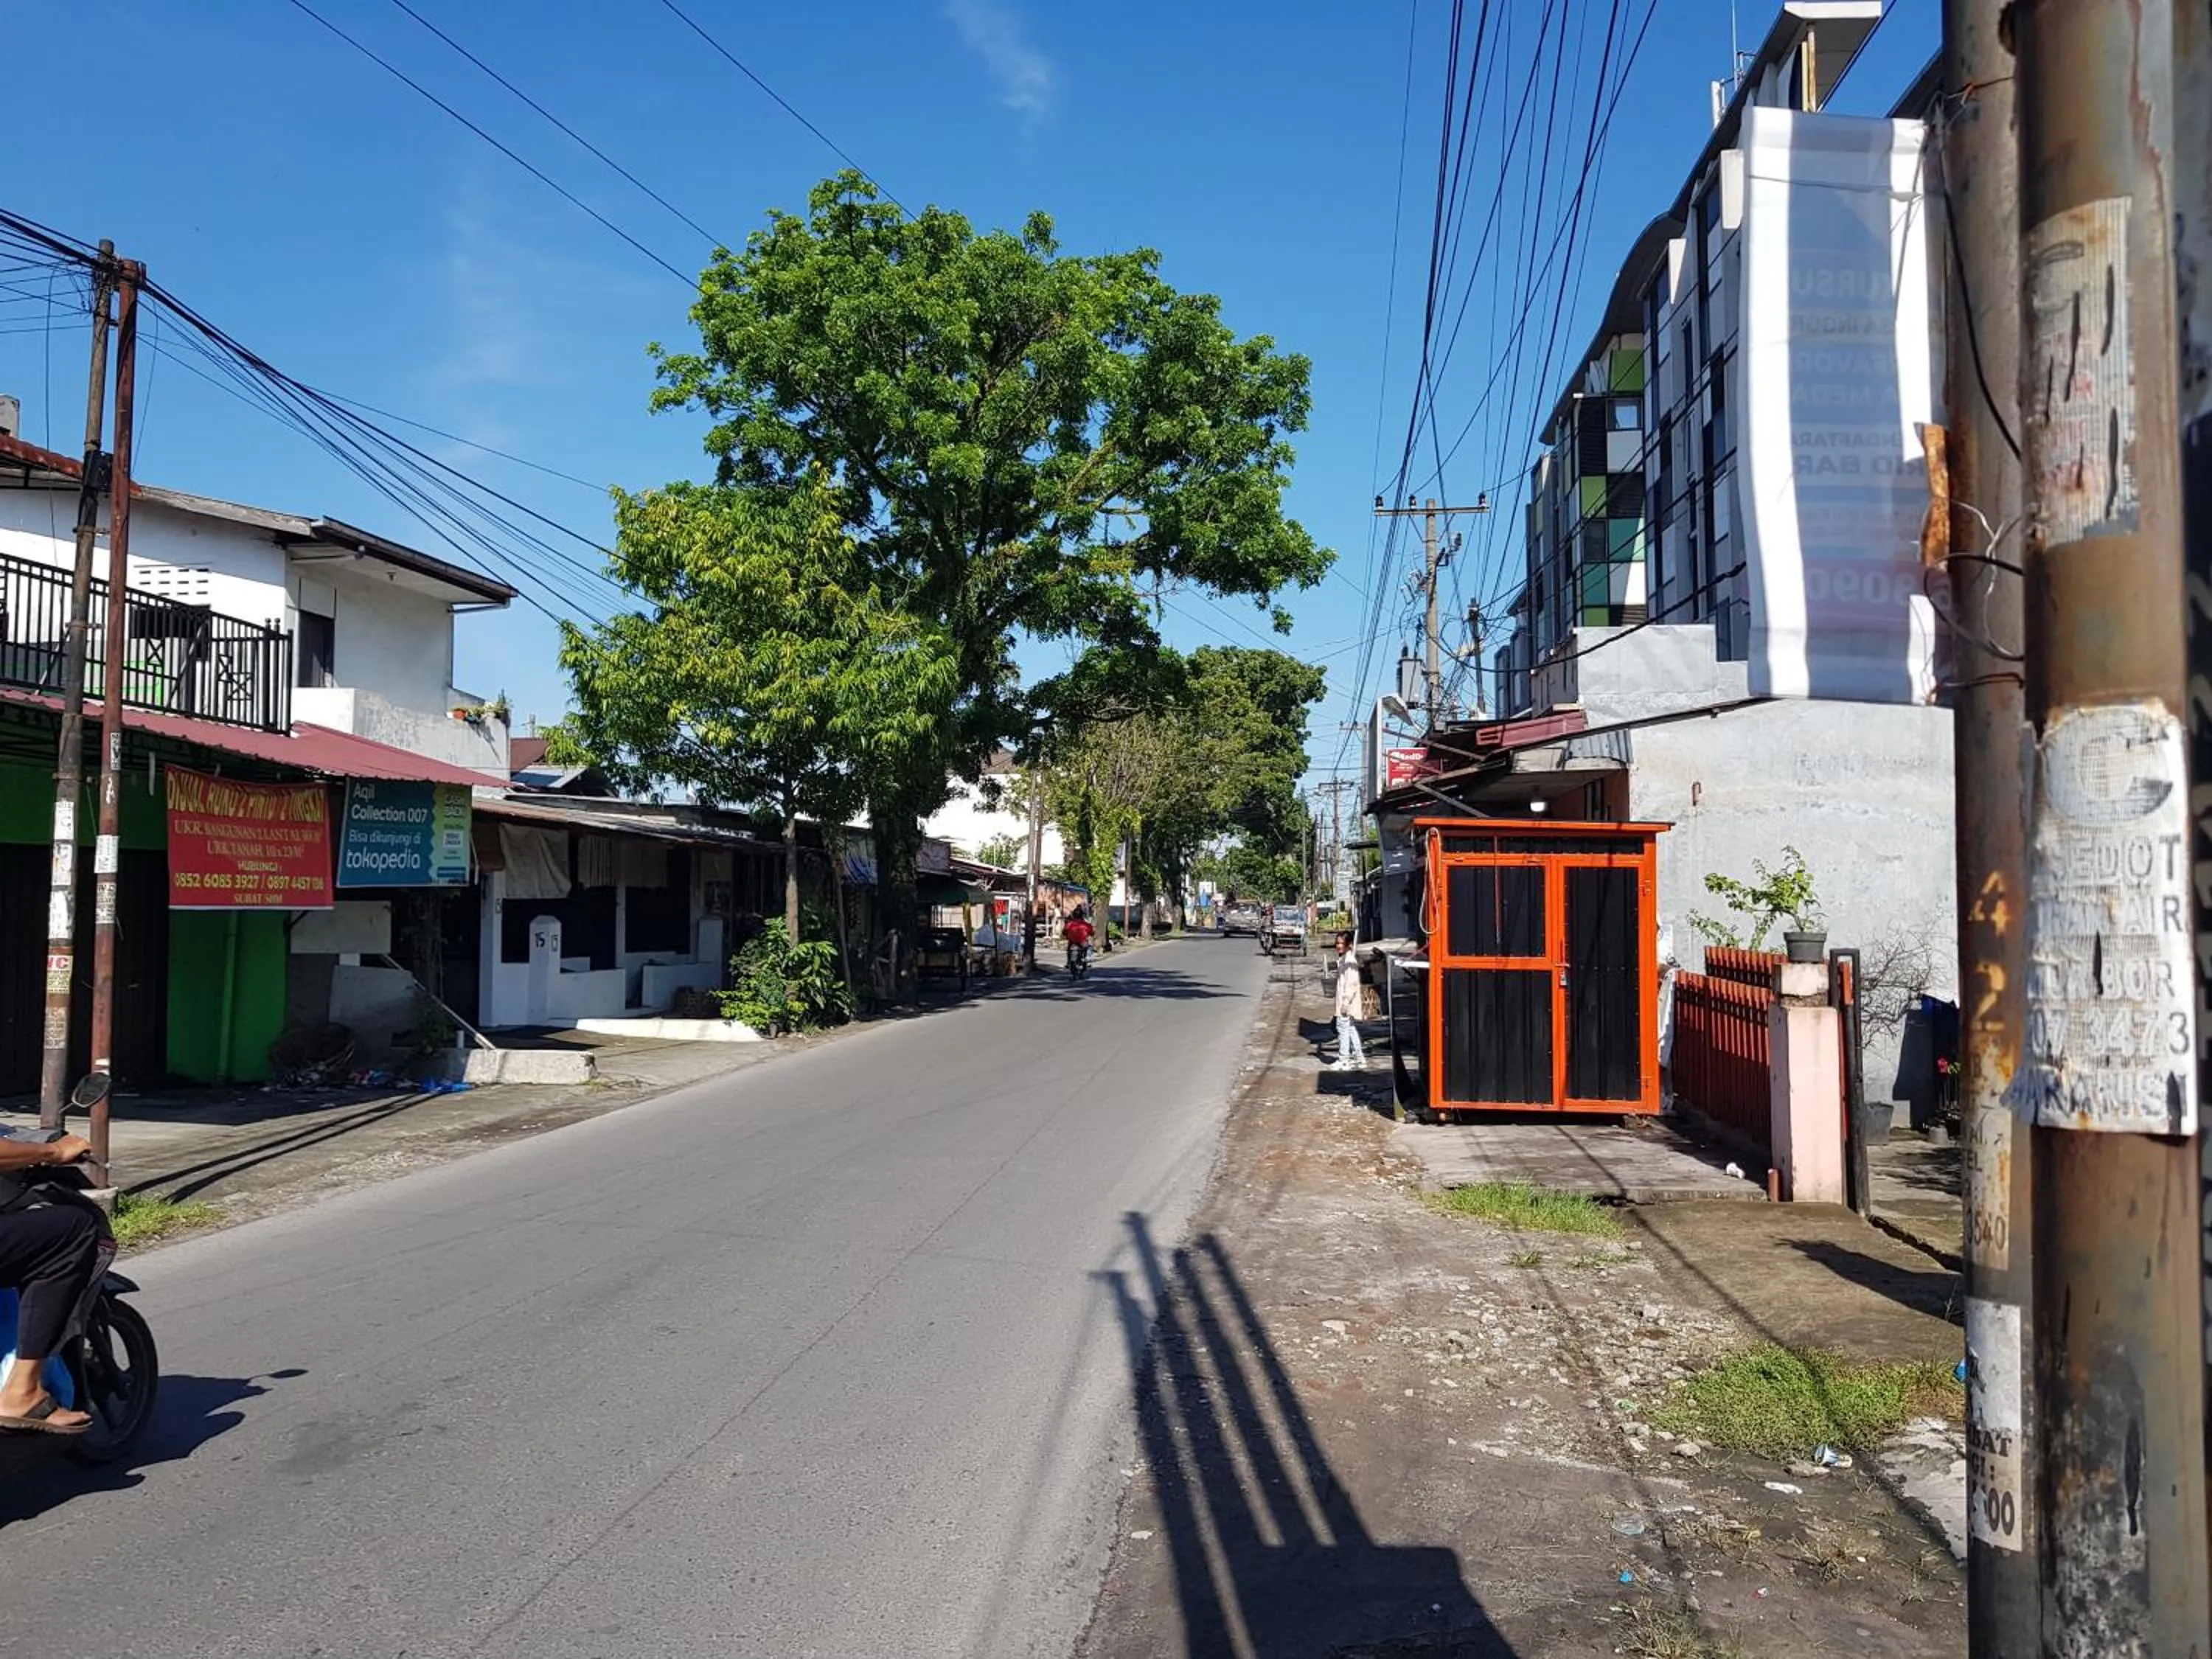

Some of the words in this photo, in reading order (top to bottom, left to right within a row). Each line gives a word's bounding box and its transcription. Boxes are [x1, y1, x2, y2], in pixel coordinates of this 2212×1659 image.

[352, 782, 375, 803] Aqil
[351, 804, 406, 822] Collection
[408, 808, 428, 824] 007
[349, 830, 368, 843] Bisa
[346, 846, 421, 874] tokopedia
